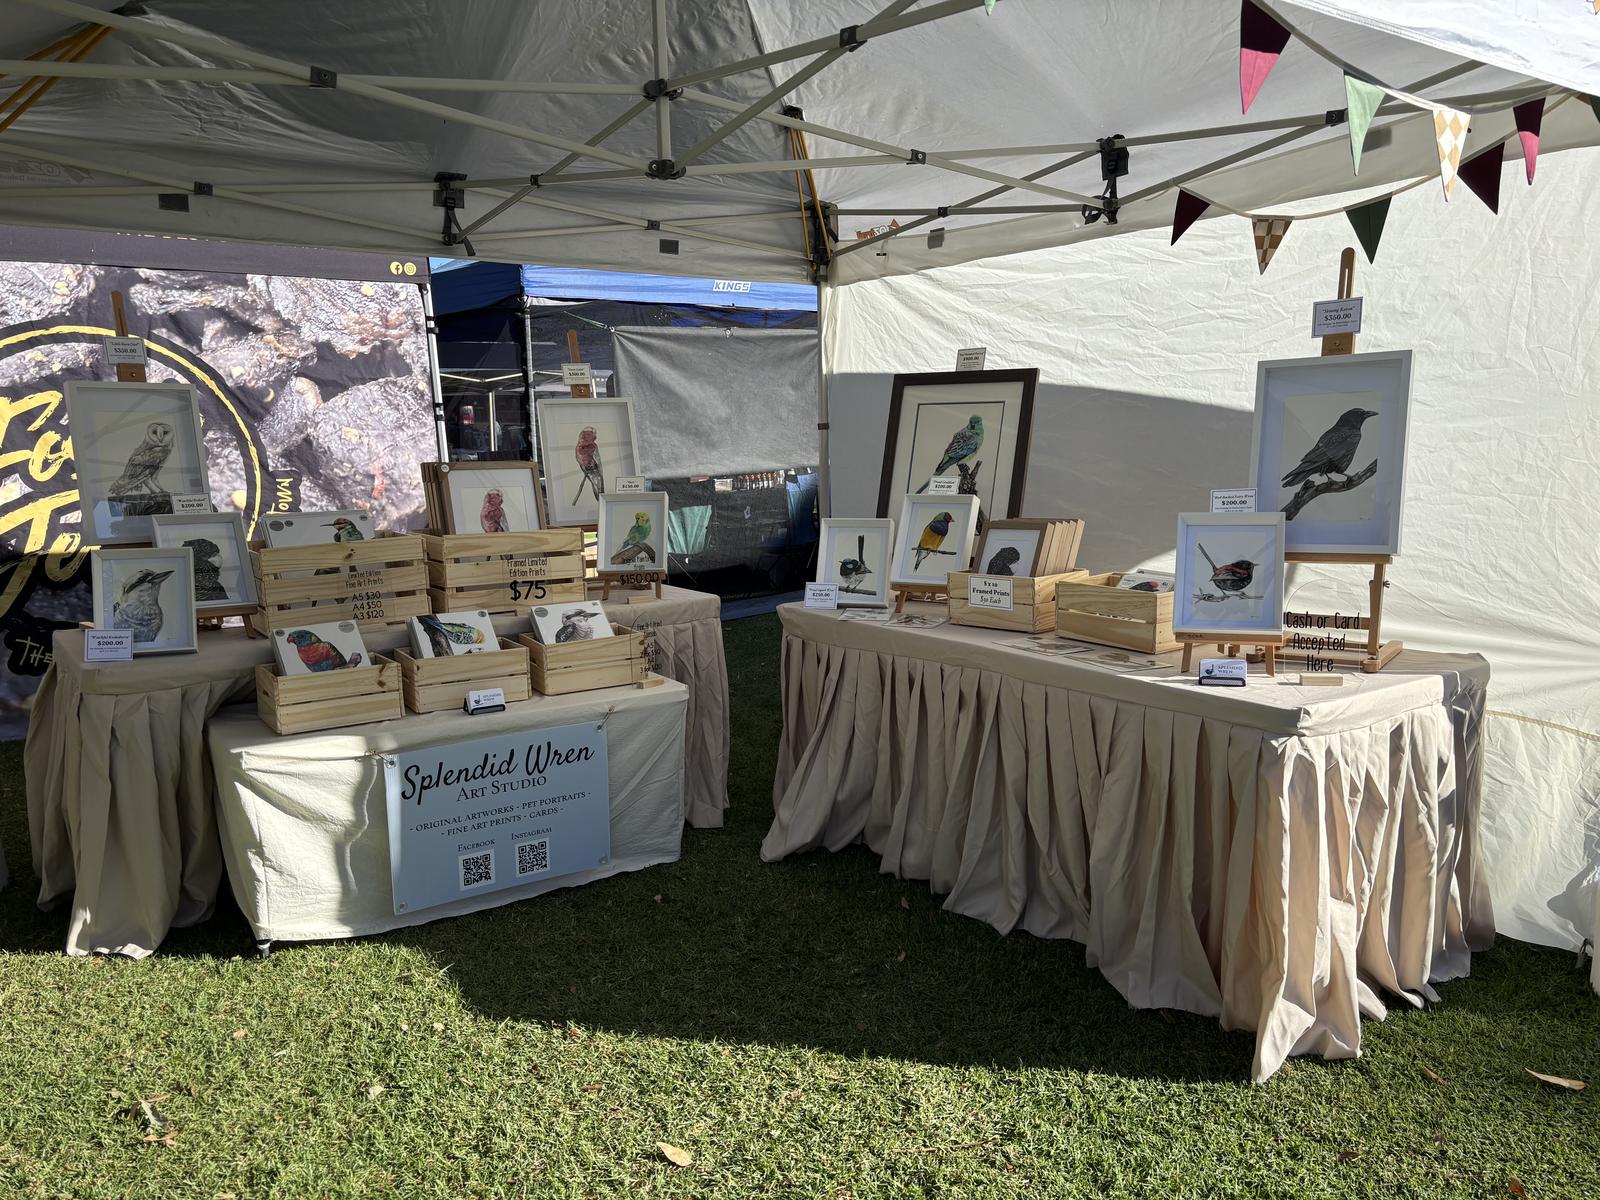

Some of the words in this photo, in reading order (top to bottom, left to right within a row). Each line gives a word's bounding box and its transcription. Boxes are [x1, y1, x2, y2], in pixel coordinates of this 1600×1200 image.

[714, 281, 750, 291] KINGS
[529, 568, 546, 576] Prints
[620, 572, 660, 585] $150.00
[352, 593, 364, 602] A5
[365, 591, 381, 600] $30
[510, 580, 547, 601] $75
[972, 587, 993, 595] Framed
[352, 602, 365, 611] A4
[366, 600, 382, 609] $50
[352, 612, 365, 620] A3
[366, 610, 384, 619] $120
[1286, 611, 1312, 628] Cash
[1316, 616, 1329, 629] or
[1334, 612, 1360, 629] Card
[1293, 632, 1345, 655] Accepted
[1306, 654, 1334, 672] Here
[401, 749, 518, 805] Splendid
[525, 741, 595, 775] Wren
[415, 815, 464, 832] ORIGINAL
[463, 804, 514, 821] ARTWORKS
[522, 800, 538, 810] PET
[539, 792, 586, 807] PORTRAITS
[447, 825, 468, 837] FINE
[470, 821, 489, 831] ART
[490, 814, 522, 828] PRINTS
[529, 807, 559, 820] CARDS
